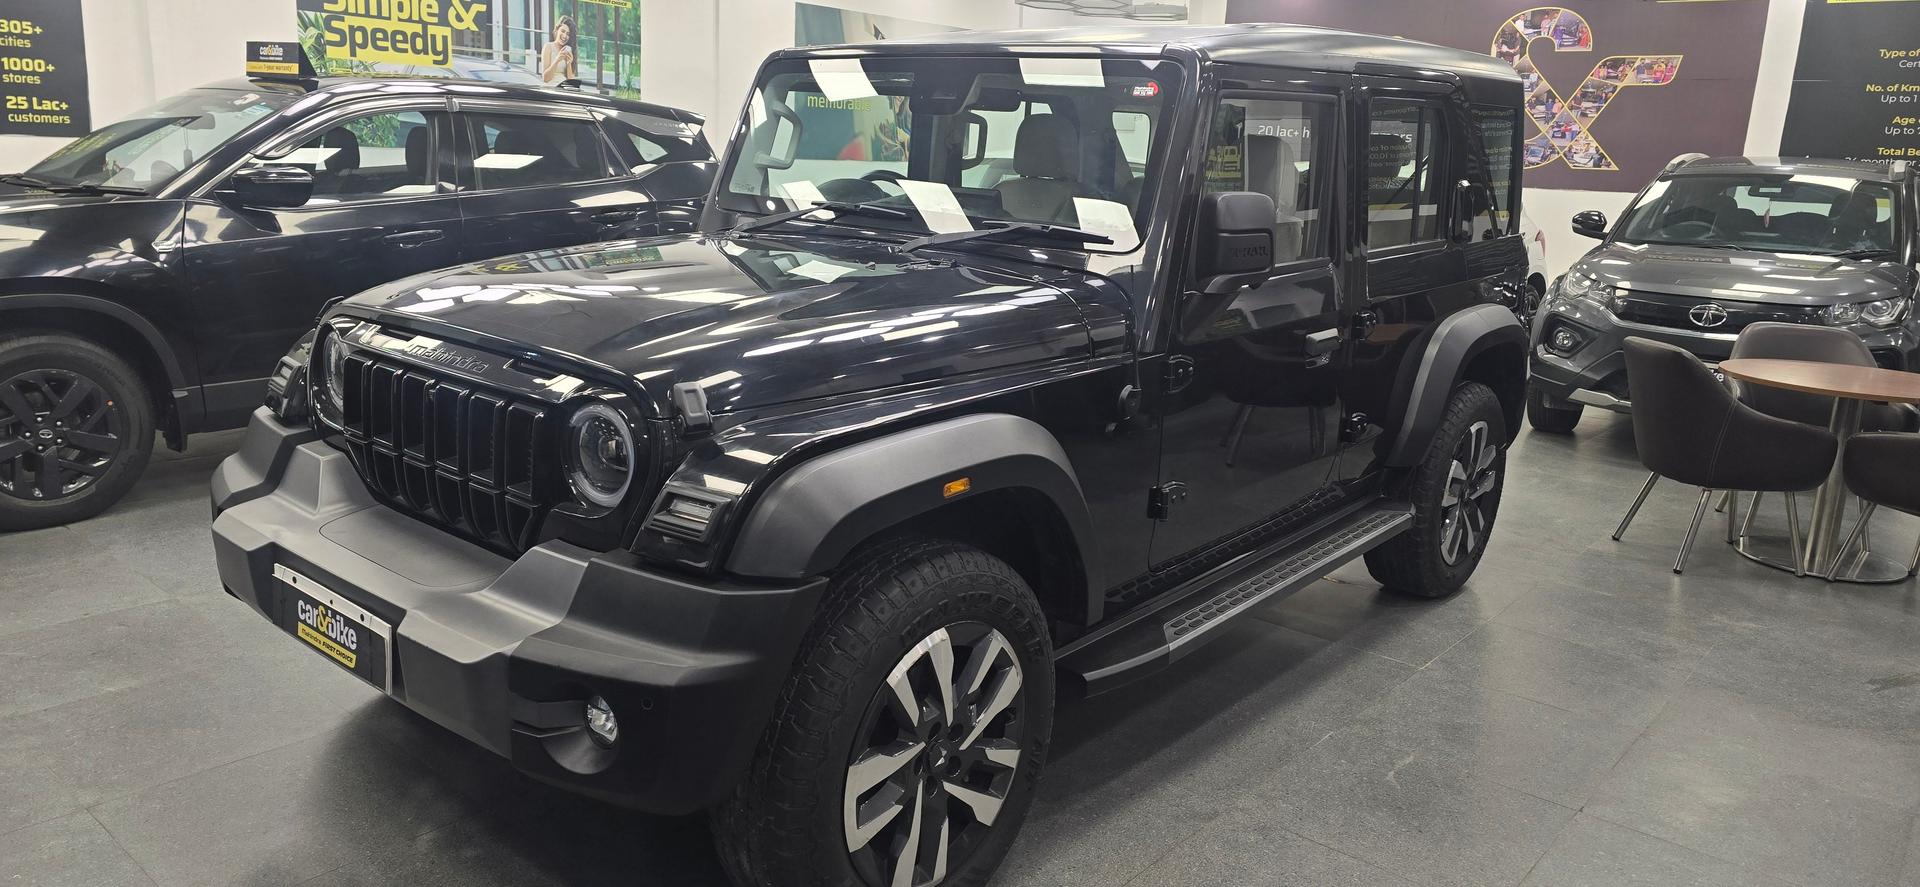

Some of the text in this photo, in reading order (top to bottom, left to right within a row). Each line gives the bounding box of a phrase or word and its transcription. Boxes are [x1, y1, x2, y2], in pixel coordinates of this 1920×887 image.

[0, 19, 43, 35] 305+
[0, 35, 32, 48] cities
[325, 14, 449, 66] Speedy
[1879, 48, 1920, 59] Type of
[1, 57, 56, 73] 1000+
[2, 73, 41, 84] stores
[1865, 83, 1884, 92] No.
[1887, 83, 1900, 92] of
[5, 95, 69, 111] 25 Lac+
[1880, 94, 1897, 105] Up
[1899, 95, 1911, 103] to
[8, 112, 71, 124] customers
[1892, 116, 1916, 126] Age
[1257, 125, 1274, 136] 20
[1276, 124, 1300, 138] lac+
[1884, 126, 1901, 136] Up
[1903, 127, 1915, 135] to
[1877, 147, 1920, 156] Total Be
[297, 599, 358, 650] car&bike
[322, 640, 337, 654] FIRST
[335, 649, 354, 664] CHOICE
